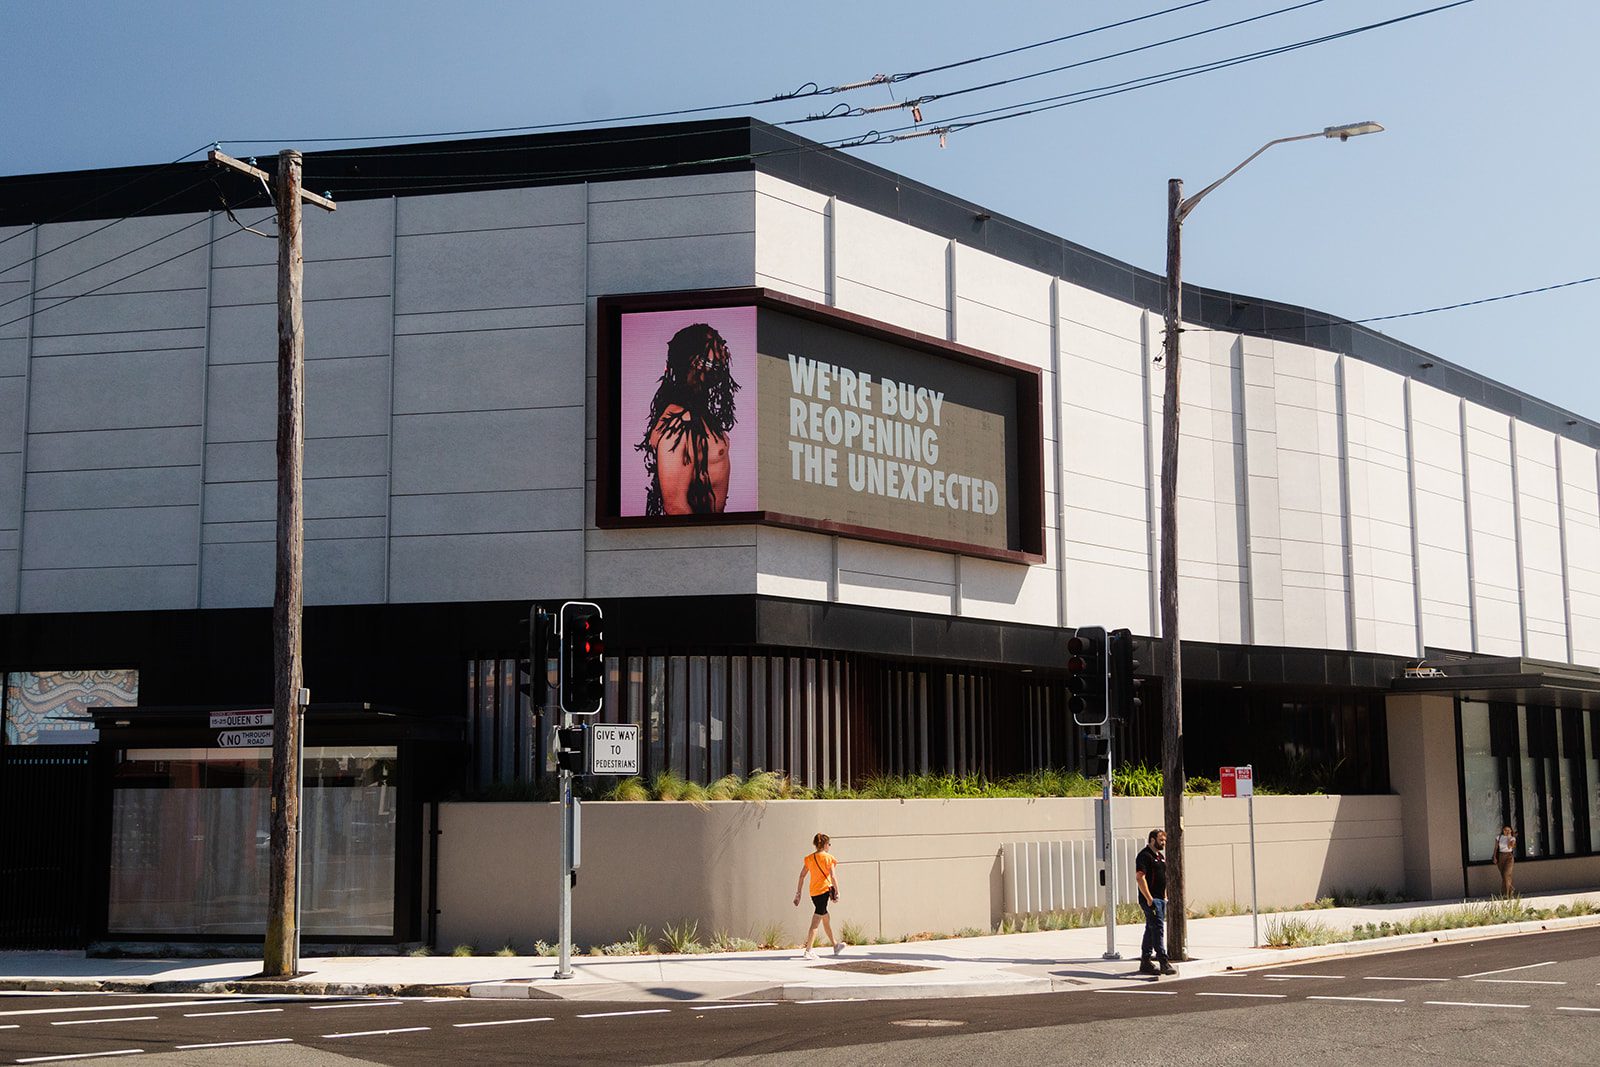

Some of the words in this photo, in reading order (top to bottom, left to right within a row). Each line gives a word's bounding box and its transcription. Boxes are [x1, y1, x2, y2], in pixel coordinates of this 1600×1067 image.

[788, 353, 872, 411] WE'RE
[881, 377, 945, 427] BUSY
[789, 397, 939, 466] REOPENING
[788, 440, 838, 488] THE
[848, 453, 999, 516] UNEXPECTED
[227, 715, 252, 726] QUEEN
[254, 715, 264, 725] ST
[226, 734, 241, 746] NO
[596, 730, 616, 740] GIVE
[618, 730, 636, 740] WAY
[610, 745, 621, 755] TO
[595, 759, 636, 768] PEDESTRIANS
